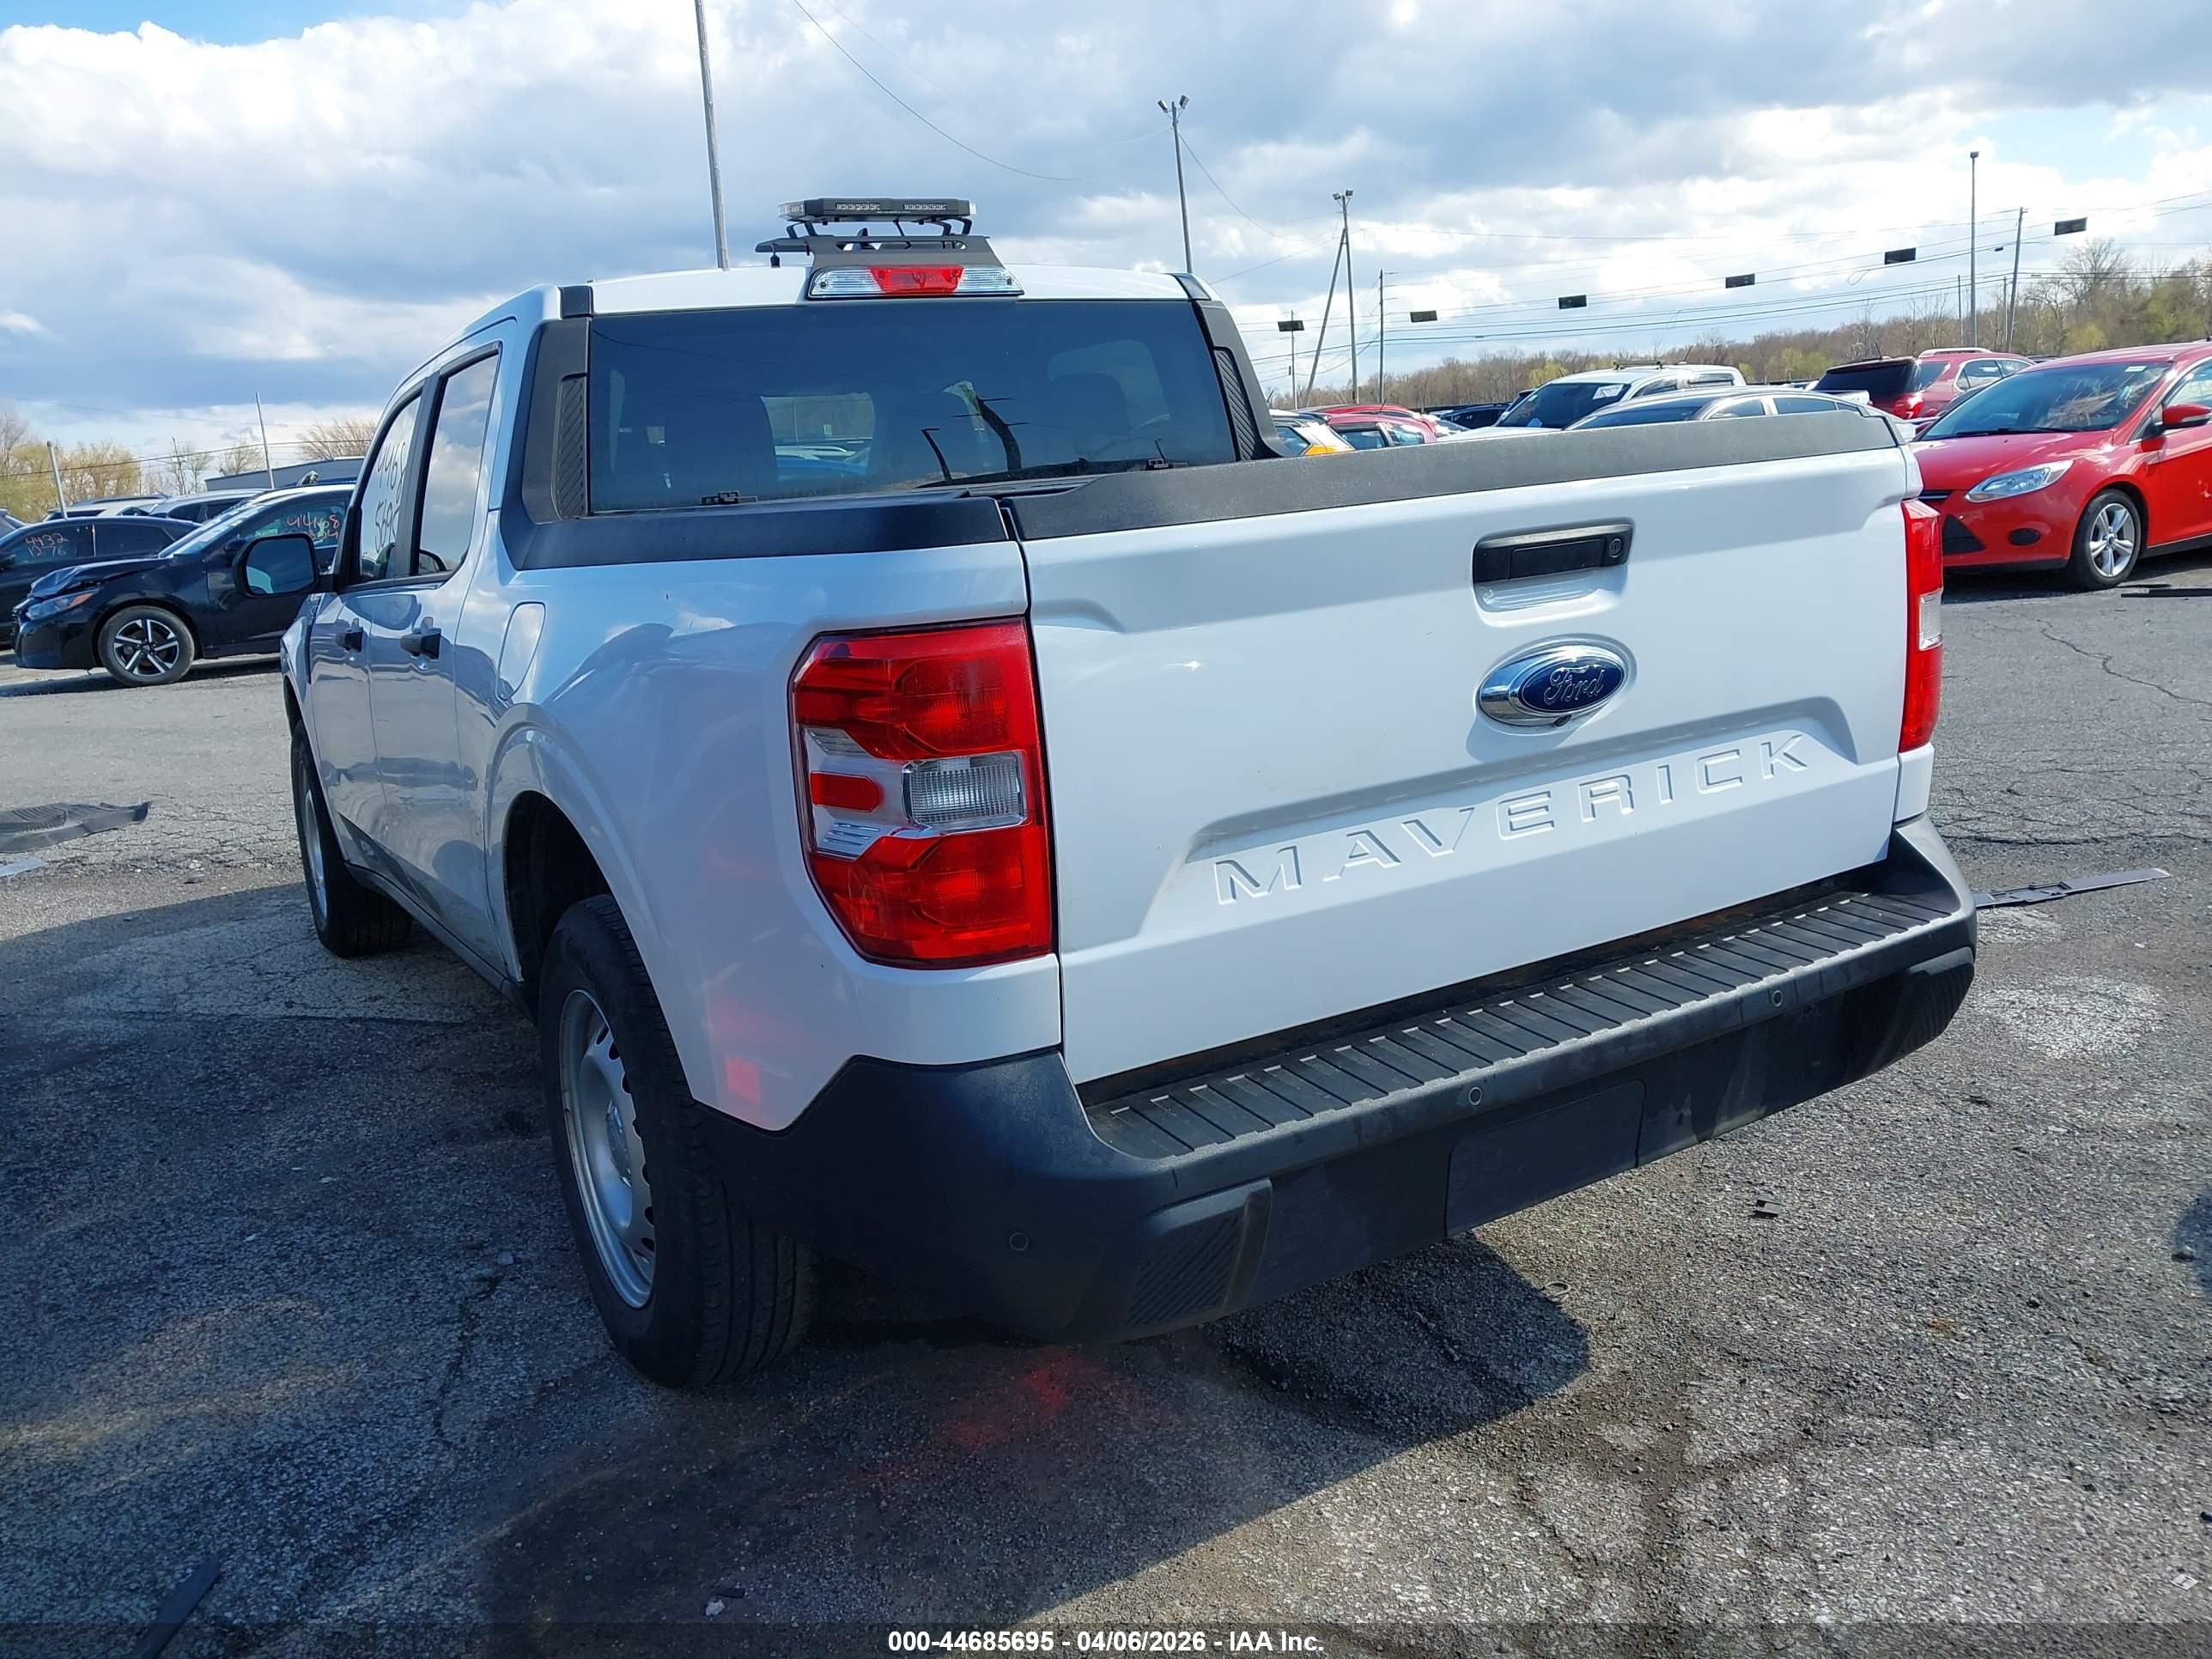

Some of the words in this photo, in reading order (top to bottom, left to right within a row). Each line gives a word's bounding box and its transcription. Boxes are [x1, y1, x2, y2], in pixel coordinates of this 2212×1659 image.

[25, 532, 69, 546] 4432
[1543, 664, 1606, 706] Ford
[1212, 732, 1808, 907] MAVERICK
